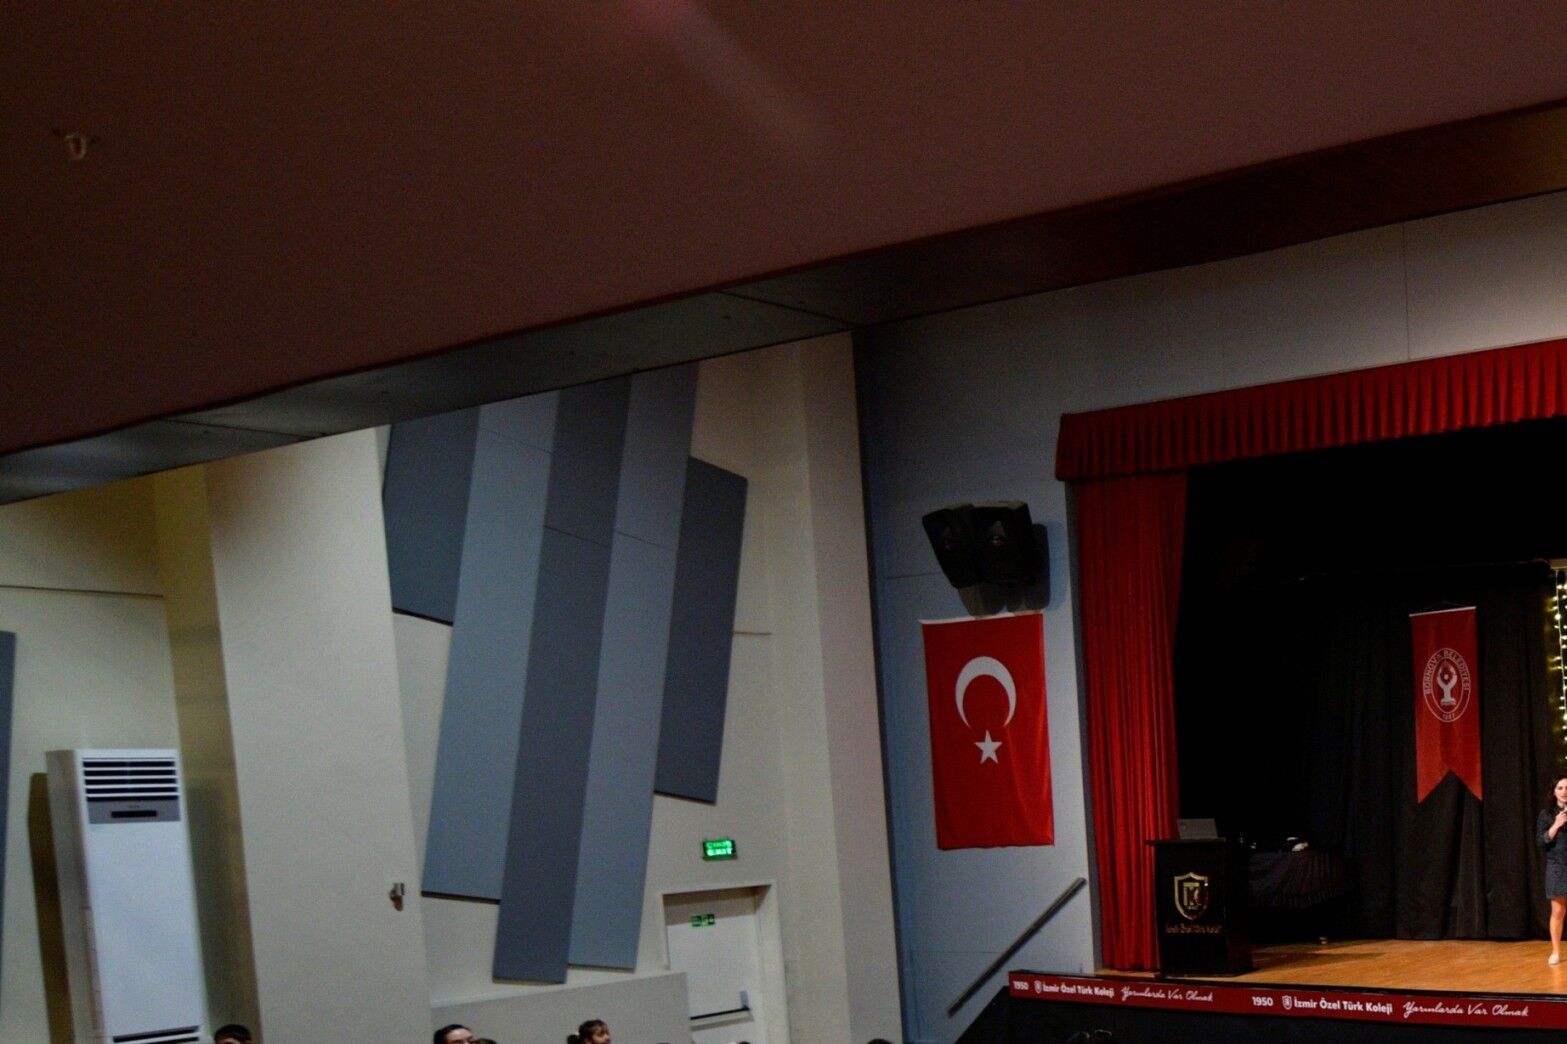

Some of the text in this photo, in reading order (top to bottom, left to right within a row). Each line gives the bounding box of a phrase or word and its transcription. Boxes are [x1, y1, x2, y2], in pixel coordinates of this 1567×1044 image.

[1077, 985, 1093, 994] Türk
[1252, 996, 1274, 1006] 1950
[1294, 996, 1317, 1008] İzmir
[1319, 997, 1341, 1010] Özel
[1342, 1001, 1364, 1011] Türk
[1366, 1002, 1393, 1015] Koleji
[1467, 1003, 1488, 1016] Var
[1492, 1004, 1529, 1017] Olmak
